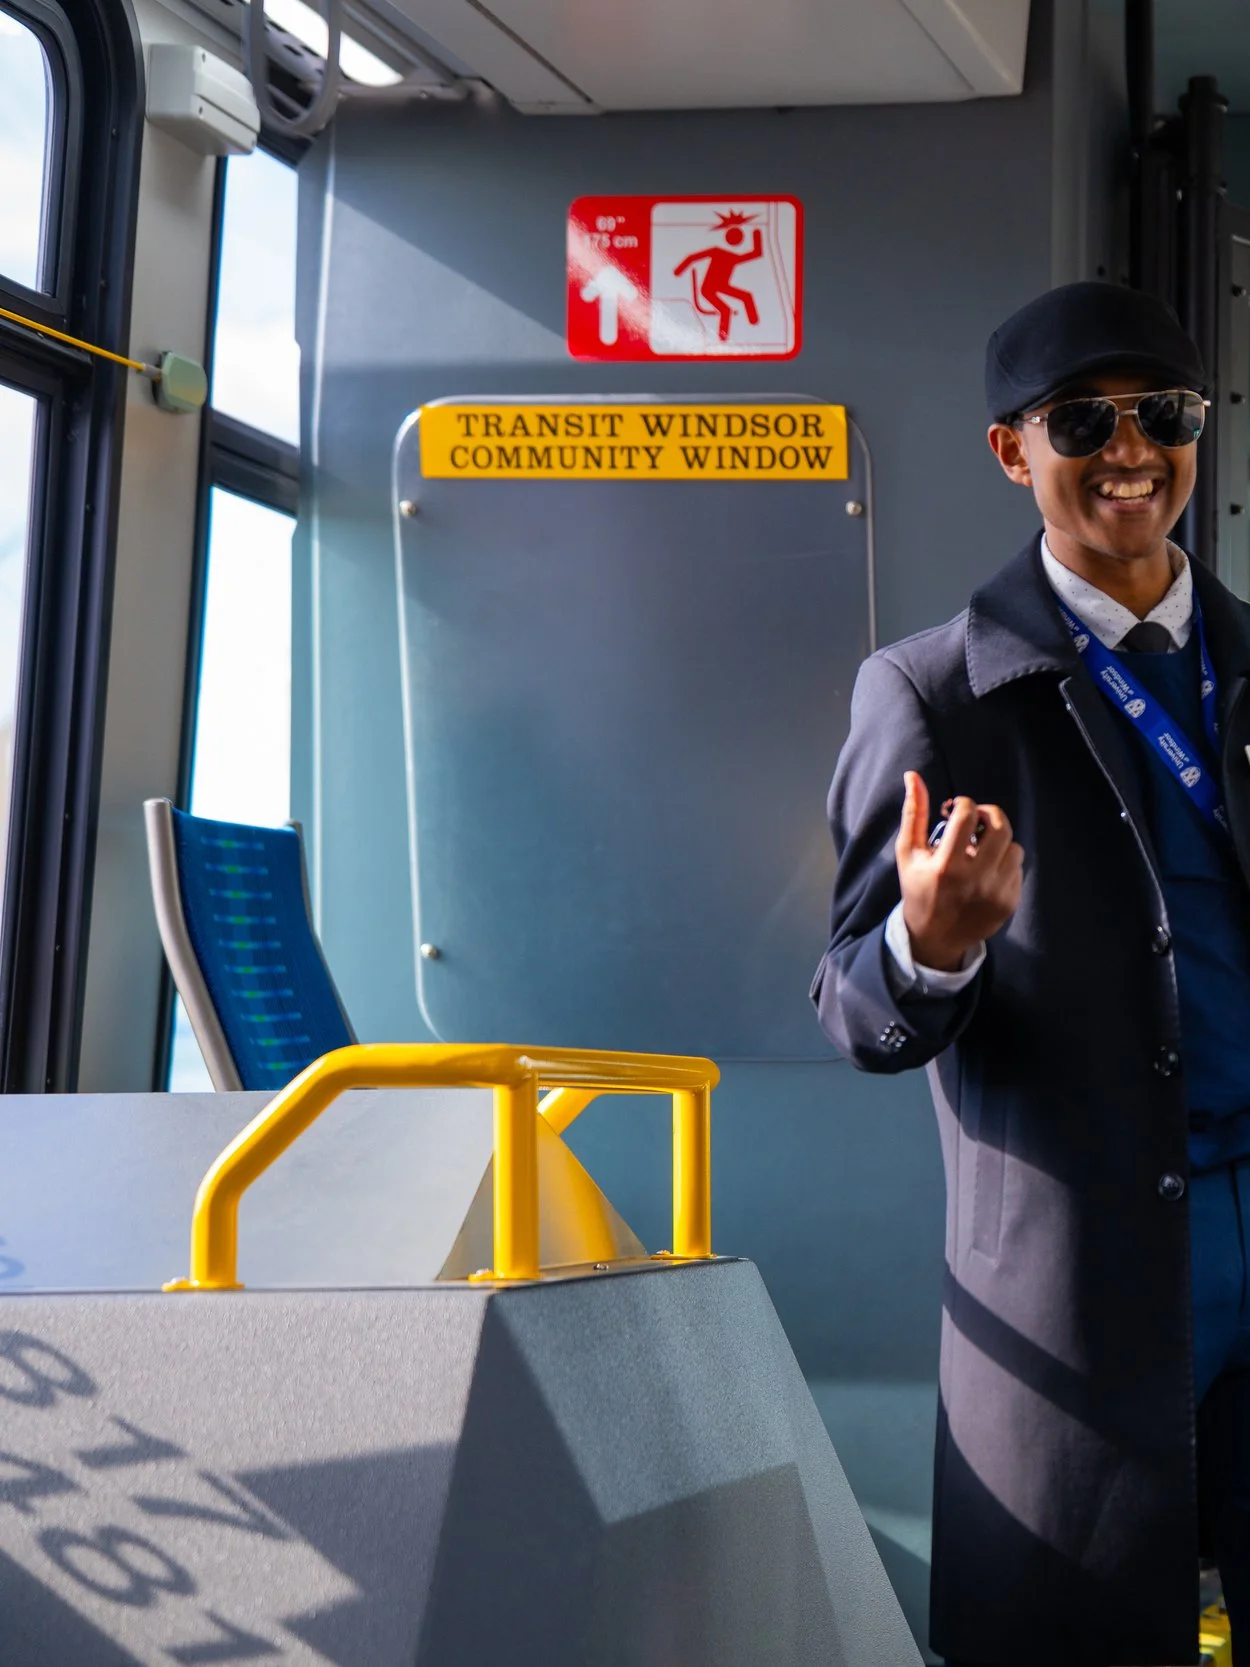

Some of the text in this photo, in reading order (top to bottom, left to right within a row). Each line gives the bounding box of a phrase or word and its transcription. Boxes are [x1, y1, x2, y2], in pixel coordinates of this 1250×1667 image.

[612, 235, 638, 249] cm
[457, 413, 824, 438] TRANSIT WINDSOR
[450, 445, 833, 470] COMMUNITY WINDOW
[1099, 669, 1128, 702] University
[1105, 664, 1130, 693] Windsor
[1156, 735, 1184, 769] University
[1162, 731, 1185, 759] Windsor
